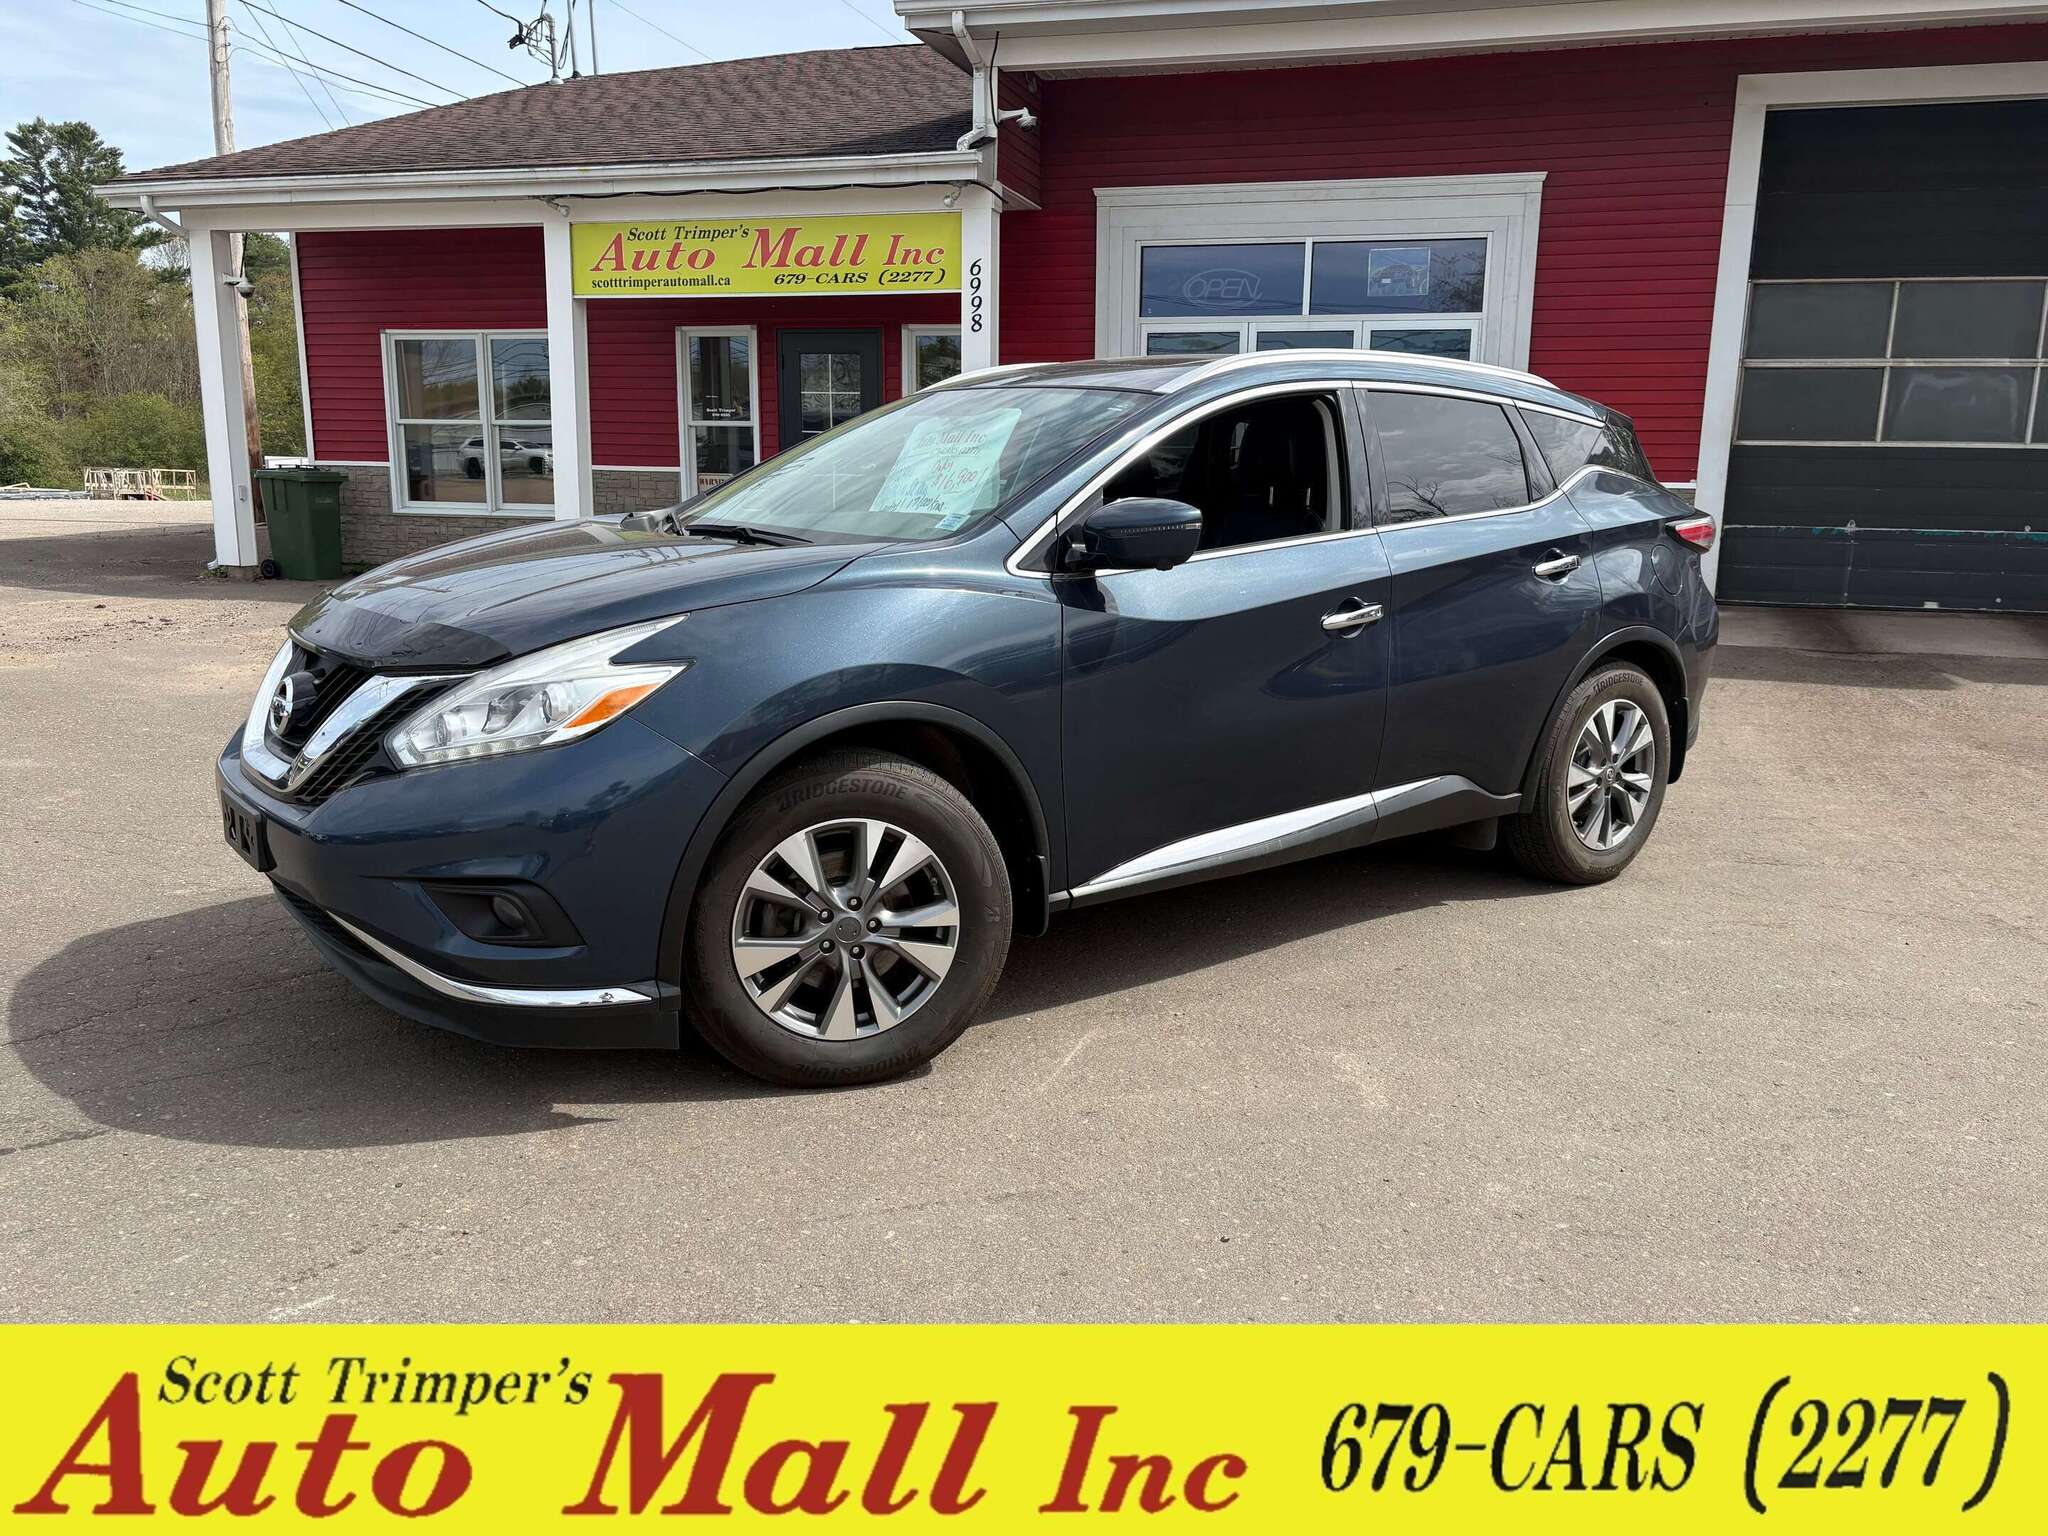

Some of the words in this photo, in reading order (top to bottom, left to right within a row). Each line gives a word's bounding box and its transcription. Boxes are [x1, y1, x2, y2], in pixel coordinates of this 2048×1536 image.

[626, 227, 667, 242] Scott
[674, 224, 750, 242] Trimper's
[590, 232, 717, 273] Auto
[742, 227, 870, 269] Mall
[881, 234, 945, 266] Inc
[591, 274, 731, 291] scotttrimperautomall.ca
[773, 271, 868, 286] 679-CARS
[877, 268, 947, 286] (2277)
[969, 258, 983, 333] 6998
[1188, 278, 1260, 299] OPEN
[778, 778, 907, 812] BRIDGESTONE
